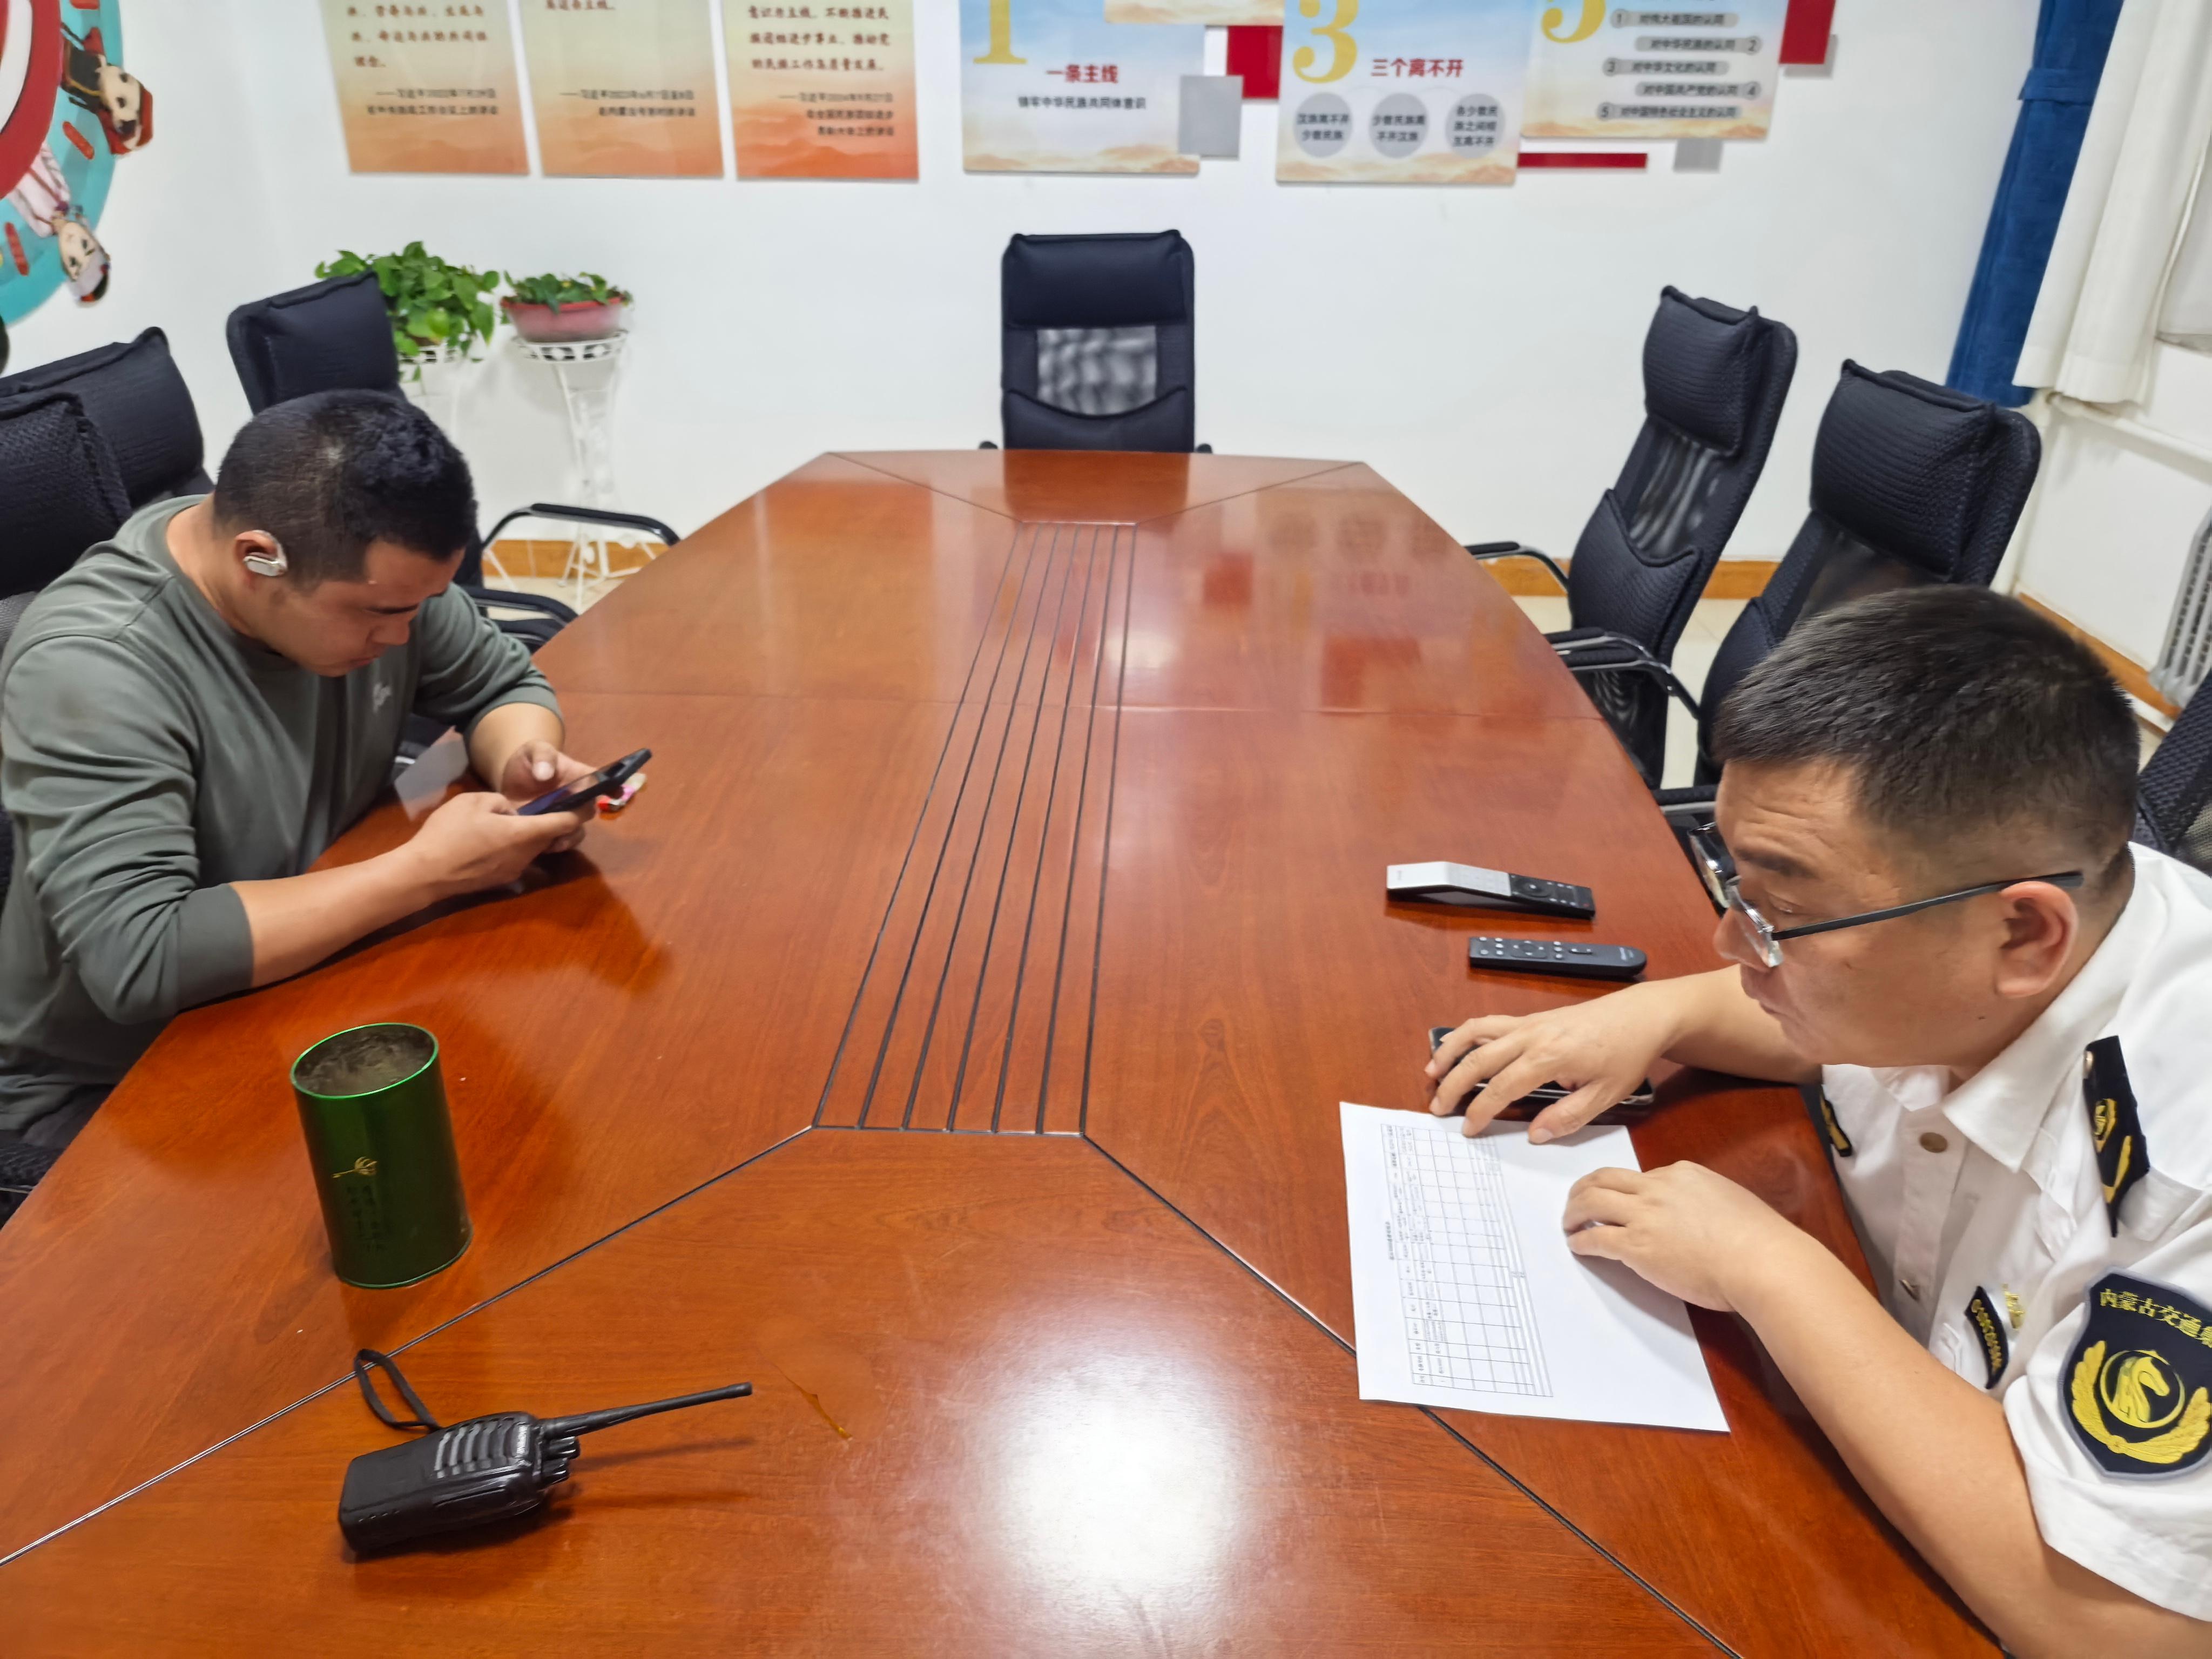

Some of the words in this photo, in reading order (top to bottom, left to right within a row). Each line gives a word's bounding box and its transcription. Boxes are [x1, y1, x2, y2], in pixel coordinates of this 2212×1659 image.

[1639, 14, 1724, 25] 对伟大祖国的认同
[1292, 0, 1359, 83] 3
[1650, 39, 1736, 50] 对中华民族的认同
[1046, 63, 1118, 84] 一条主线
[1371, 57, 1464, 78] 三个离不开
[1631, 62, 1717, 73] 对中华文化的认同
[1643, 84, 1738, 96] 对中国共产党的认同
[1018, 96, 1146, 110] 铸牢中华民族共同体意识
[1620, 106, 1736, 118] 对中国特色社会主义的认同
[1297, 113, 1350, 125] 汉族离不开
[1373, 114, 1426, 126] 少数民族离
[1302, 130, 1343, 140] 少数民族
[1377, 131, 1419, 142] 不开汉族
